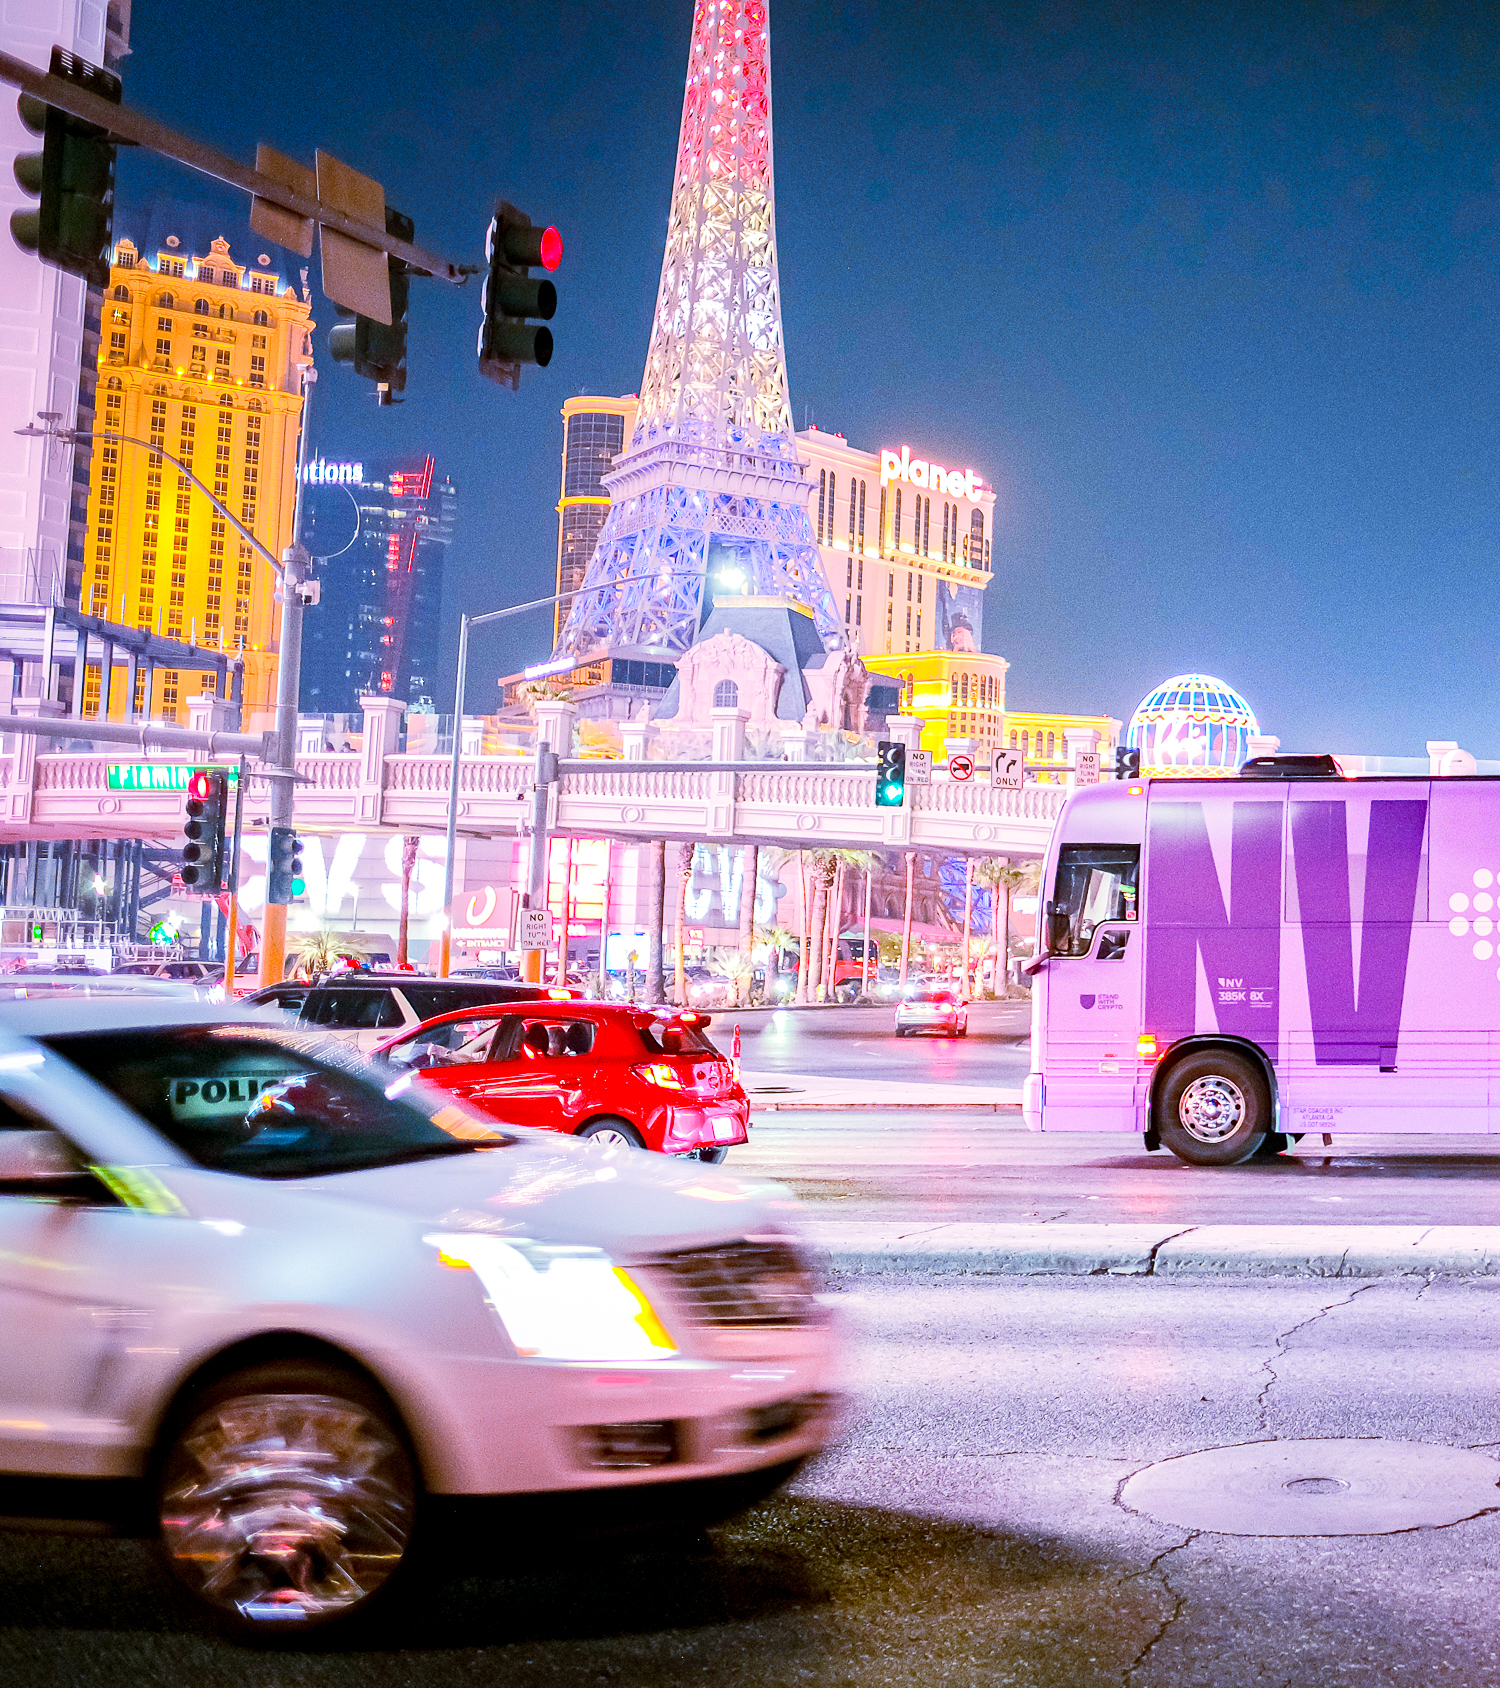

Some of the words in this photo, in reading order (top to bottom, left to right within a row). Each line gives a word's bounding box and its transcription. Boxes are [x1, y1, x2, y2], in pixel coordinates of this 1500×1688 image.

[294, 457, 363, 485] ations
[880, 444, 984, 503] planet
[1082, 755, 1094, 763] NO
[995, 776, 1018, 786] ONLY
[529, 913, 544, 922] NO
[1143, 799, 1429, 1066] NV
[466, 939, 505, 948] ENTRANCE
[1225, 978, 1243, 988] NV
[1218, 991, 1246, 1001] 385K
[1250, 991, 1264, 1001] 8X
[175, 1080, 282, 1105] POLI
